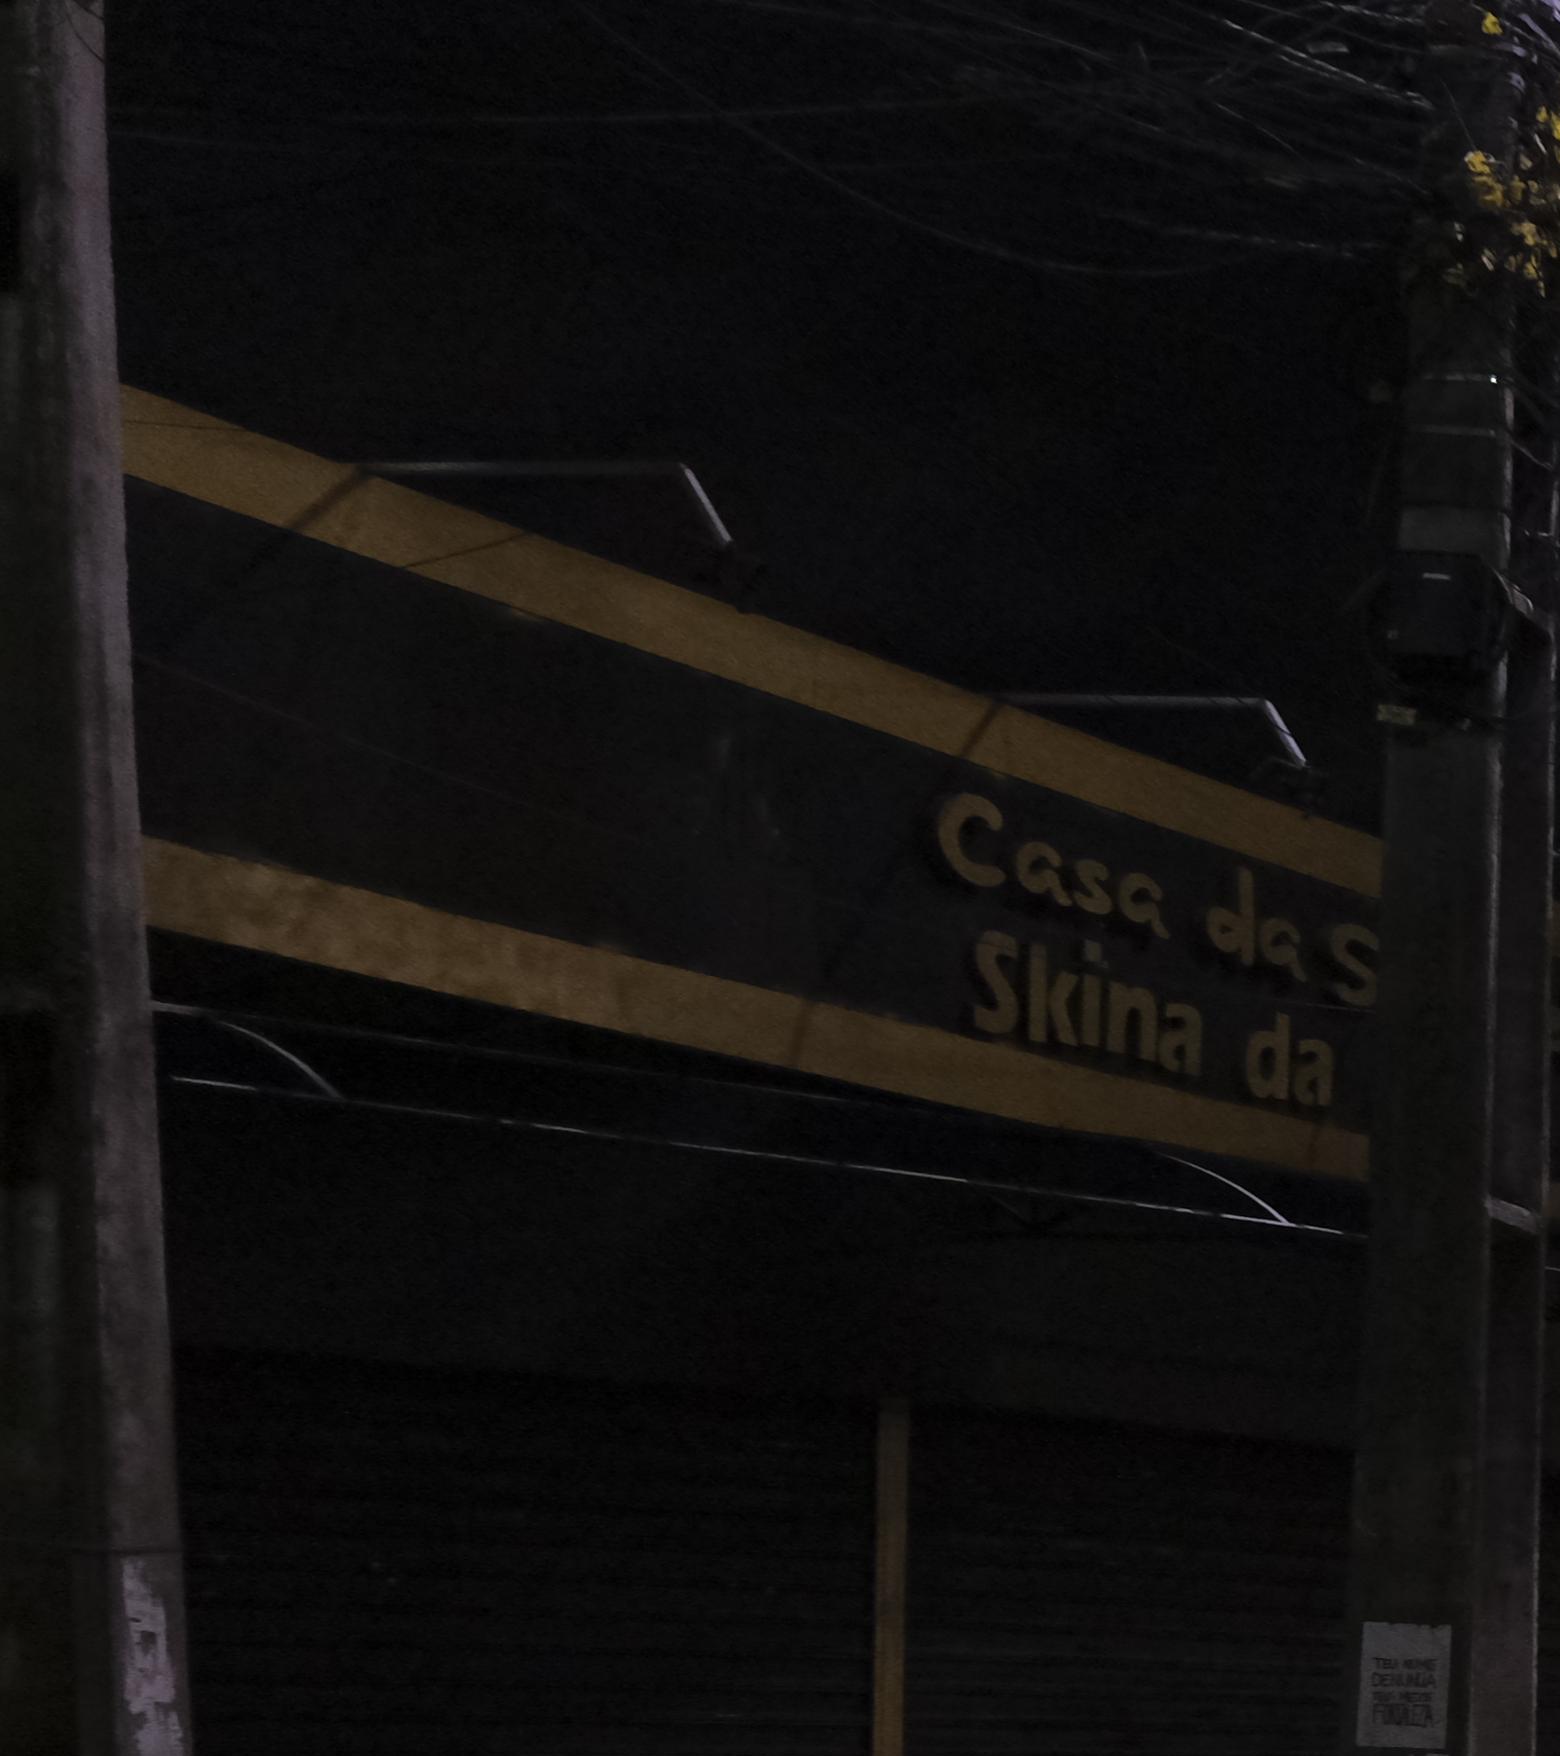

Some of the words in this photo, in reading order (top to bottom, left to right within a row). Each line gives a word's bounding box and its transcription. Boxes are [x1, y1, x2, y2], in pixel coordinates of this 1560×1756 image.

[936, 792, 1165, 939] Casa
[1204, 866, 1307, 984] da
[970, 930, 1198, 1076] Skina
[1245, 1012, 1333, 1109] da
